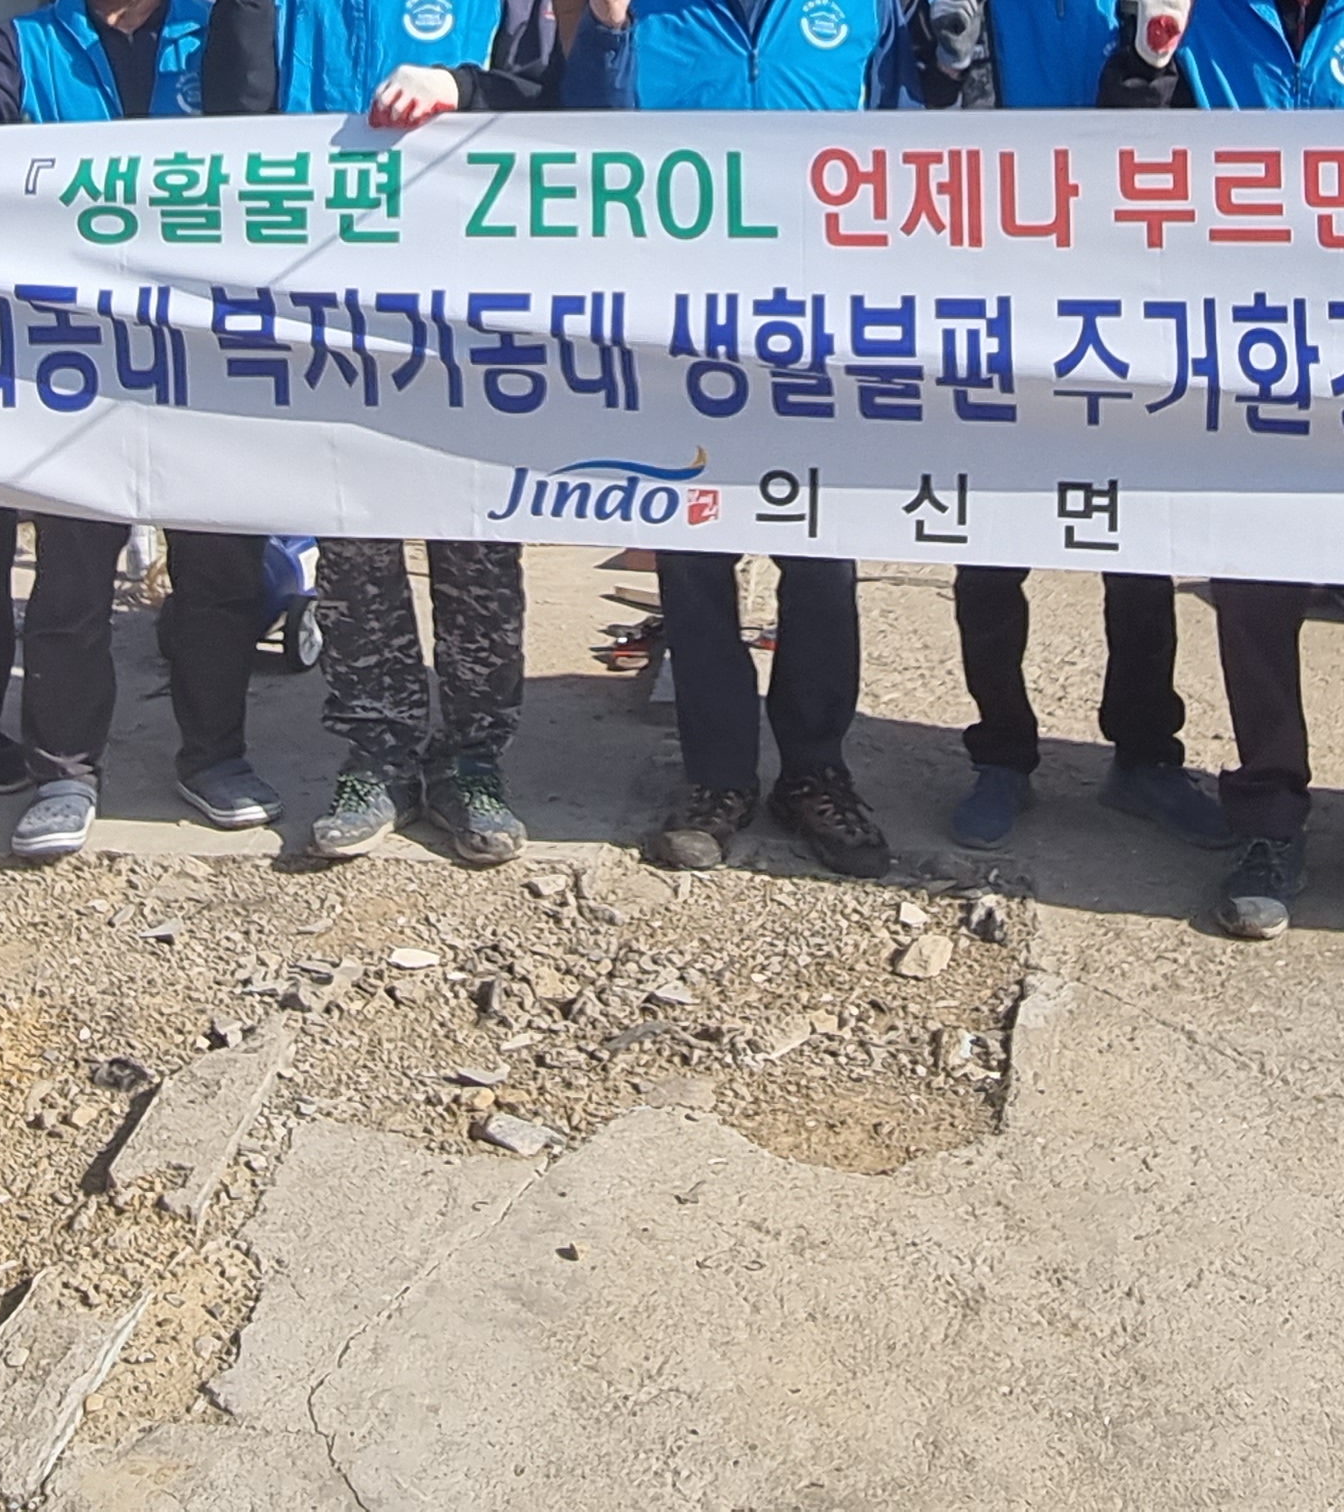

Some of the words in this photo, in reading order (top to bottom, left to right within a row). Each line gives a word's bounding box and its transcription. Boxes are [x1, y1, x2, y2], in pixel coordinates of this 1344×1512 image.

[465, 148, 779, 239] ZEROL
[810, 147, 1080, 247] 언제나
[669, 287, 1017, 422] 생활불편
